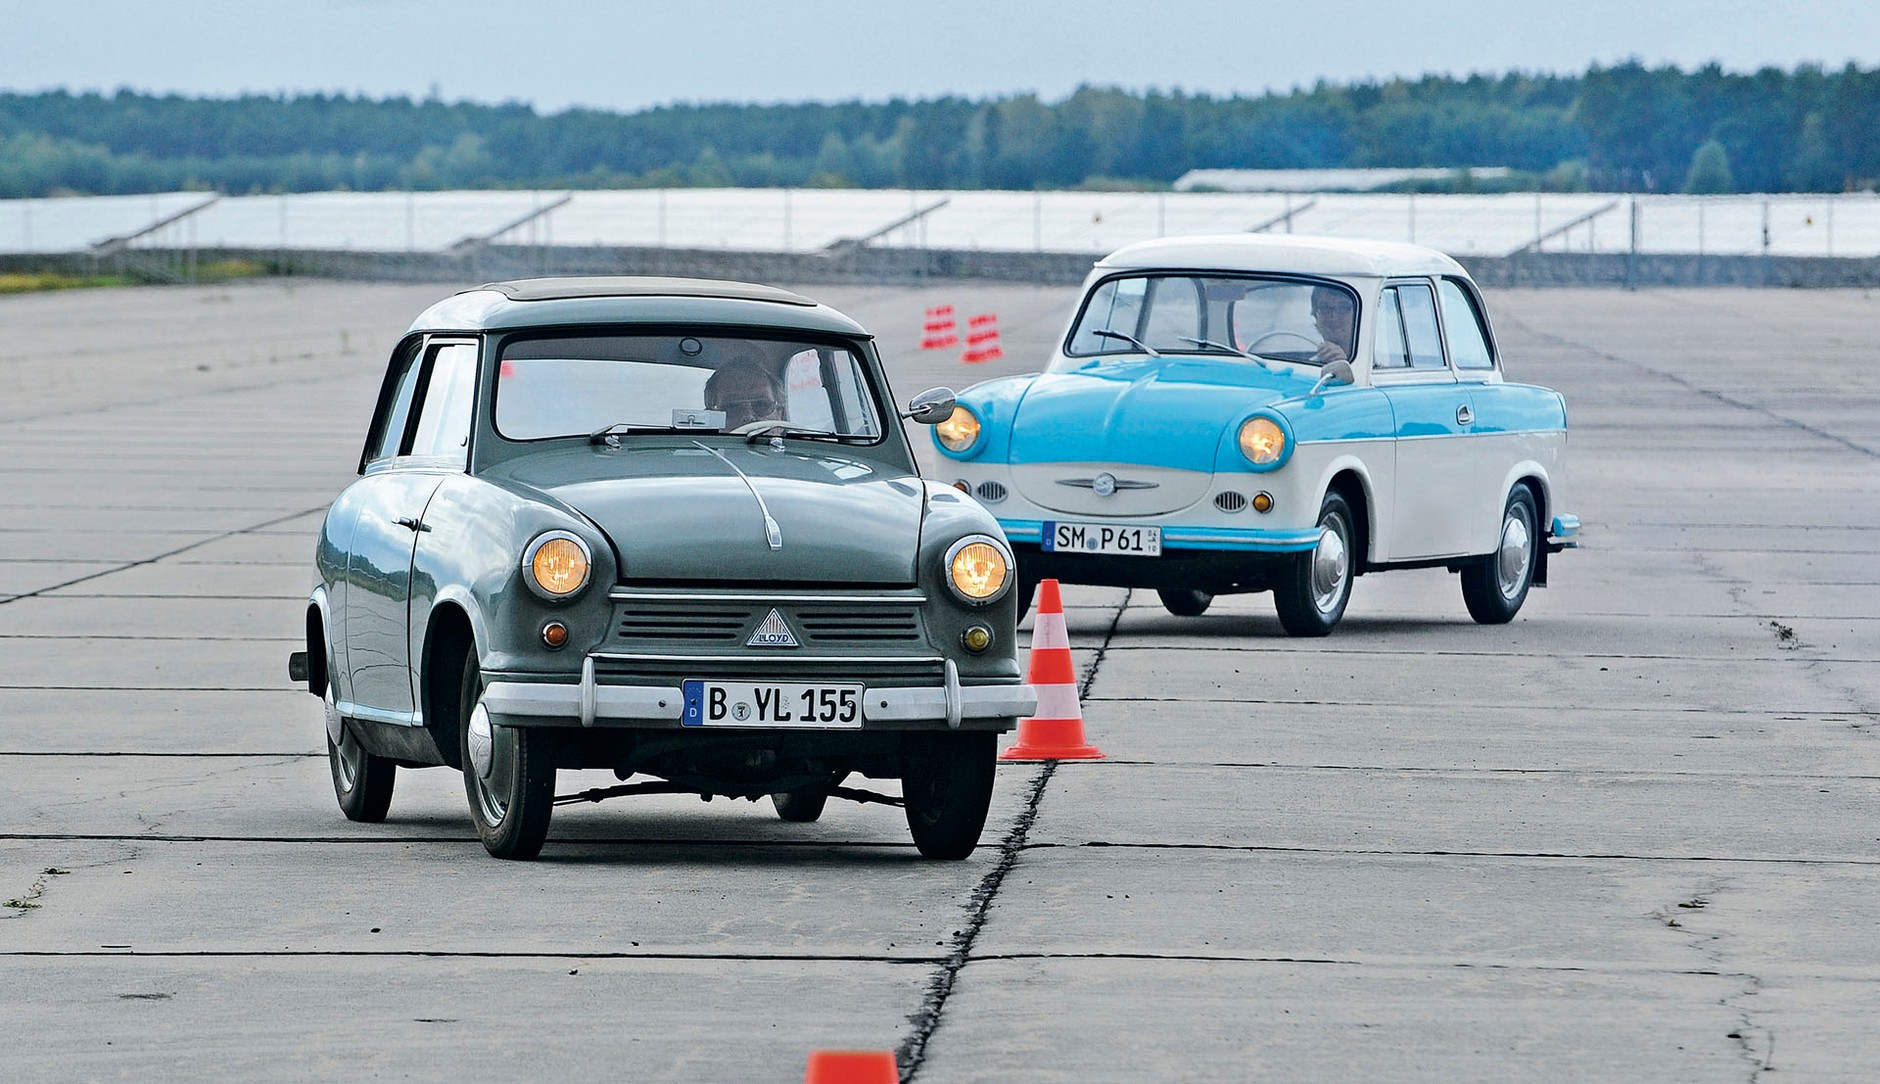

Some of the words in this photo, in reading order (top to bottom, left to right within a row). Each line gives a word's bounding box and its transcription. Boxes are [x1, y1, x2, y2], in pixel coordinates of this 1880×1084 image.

[1057, 526, 1085, 548] SM
[1101, 528, 1114, 549] P
[1117, 529, 1143, 551] 61
[759, 634, 789, 642] LLOYD
[690, 707, 697, 717] D
[709, 687, 727, 720] B
[754, 688, 791, 721] YL
[800, 689, 856, 722] 155
